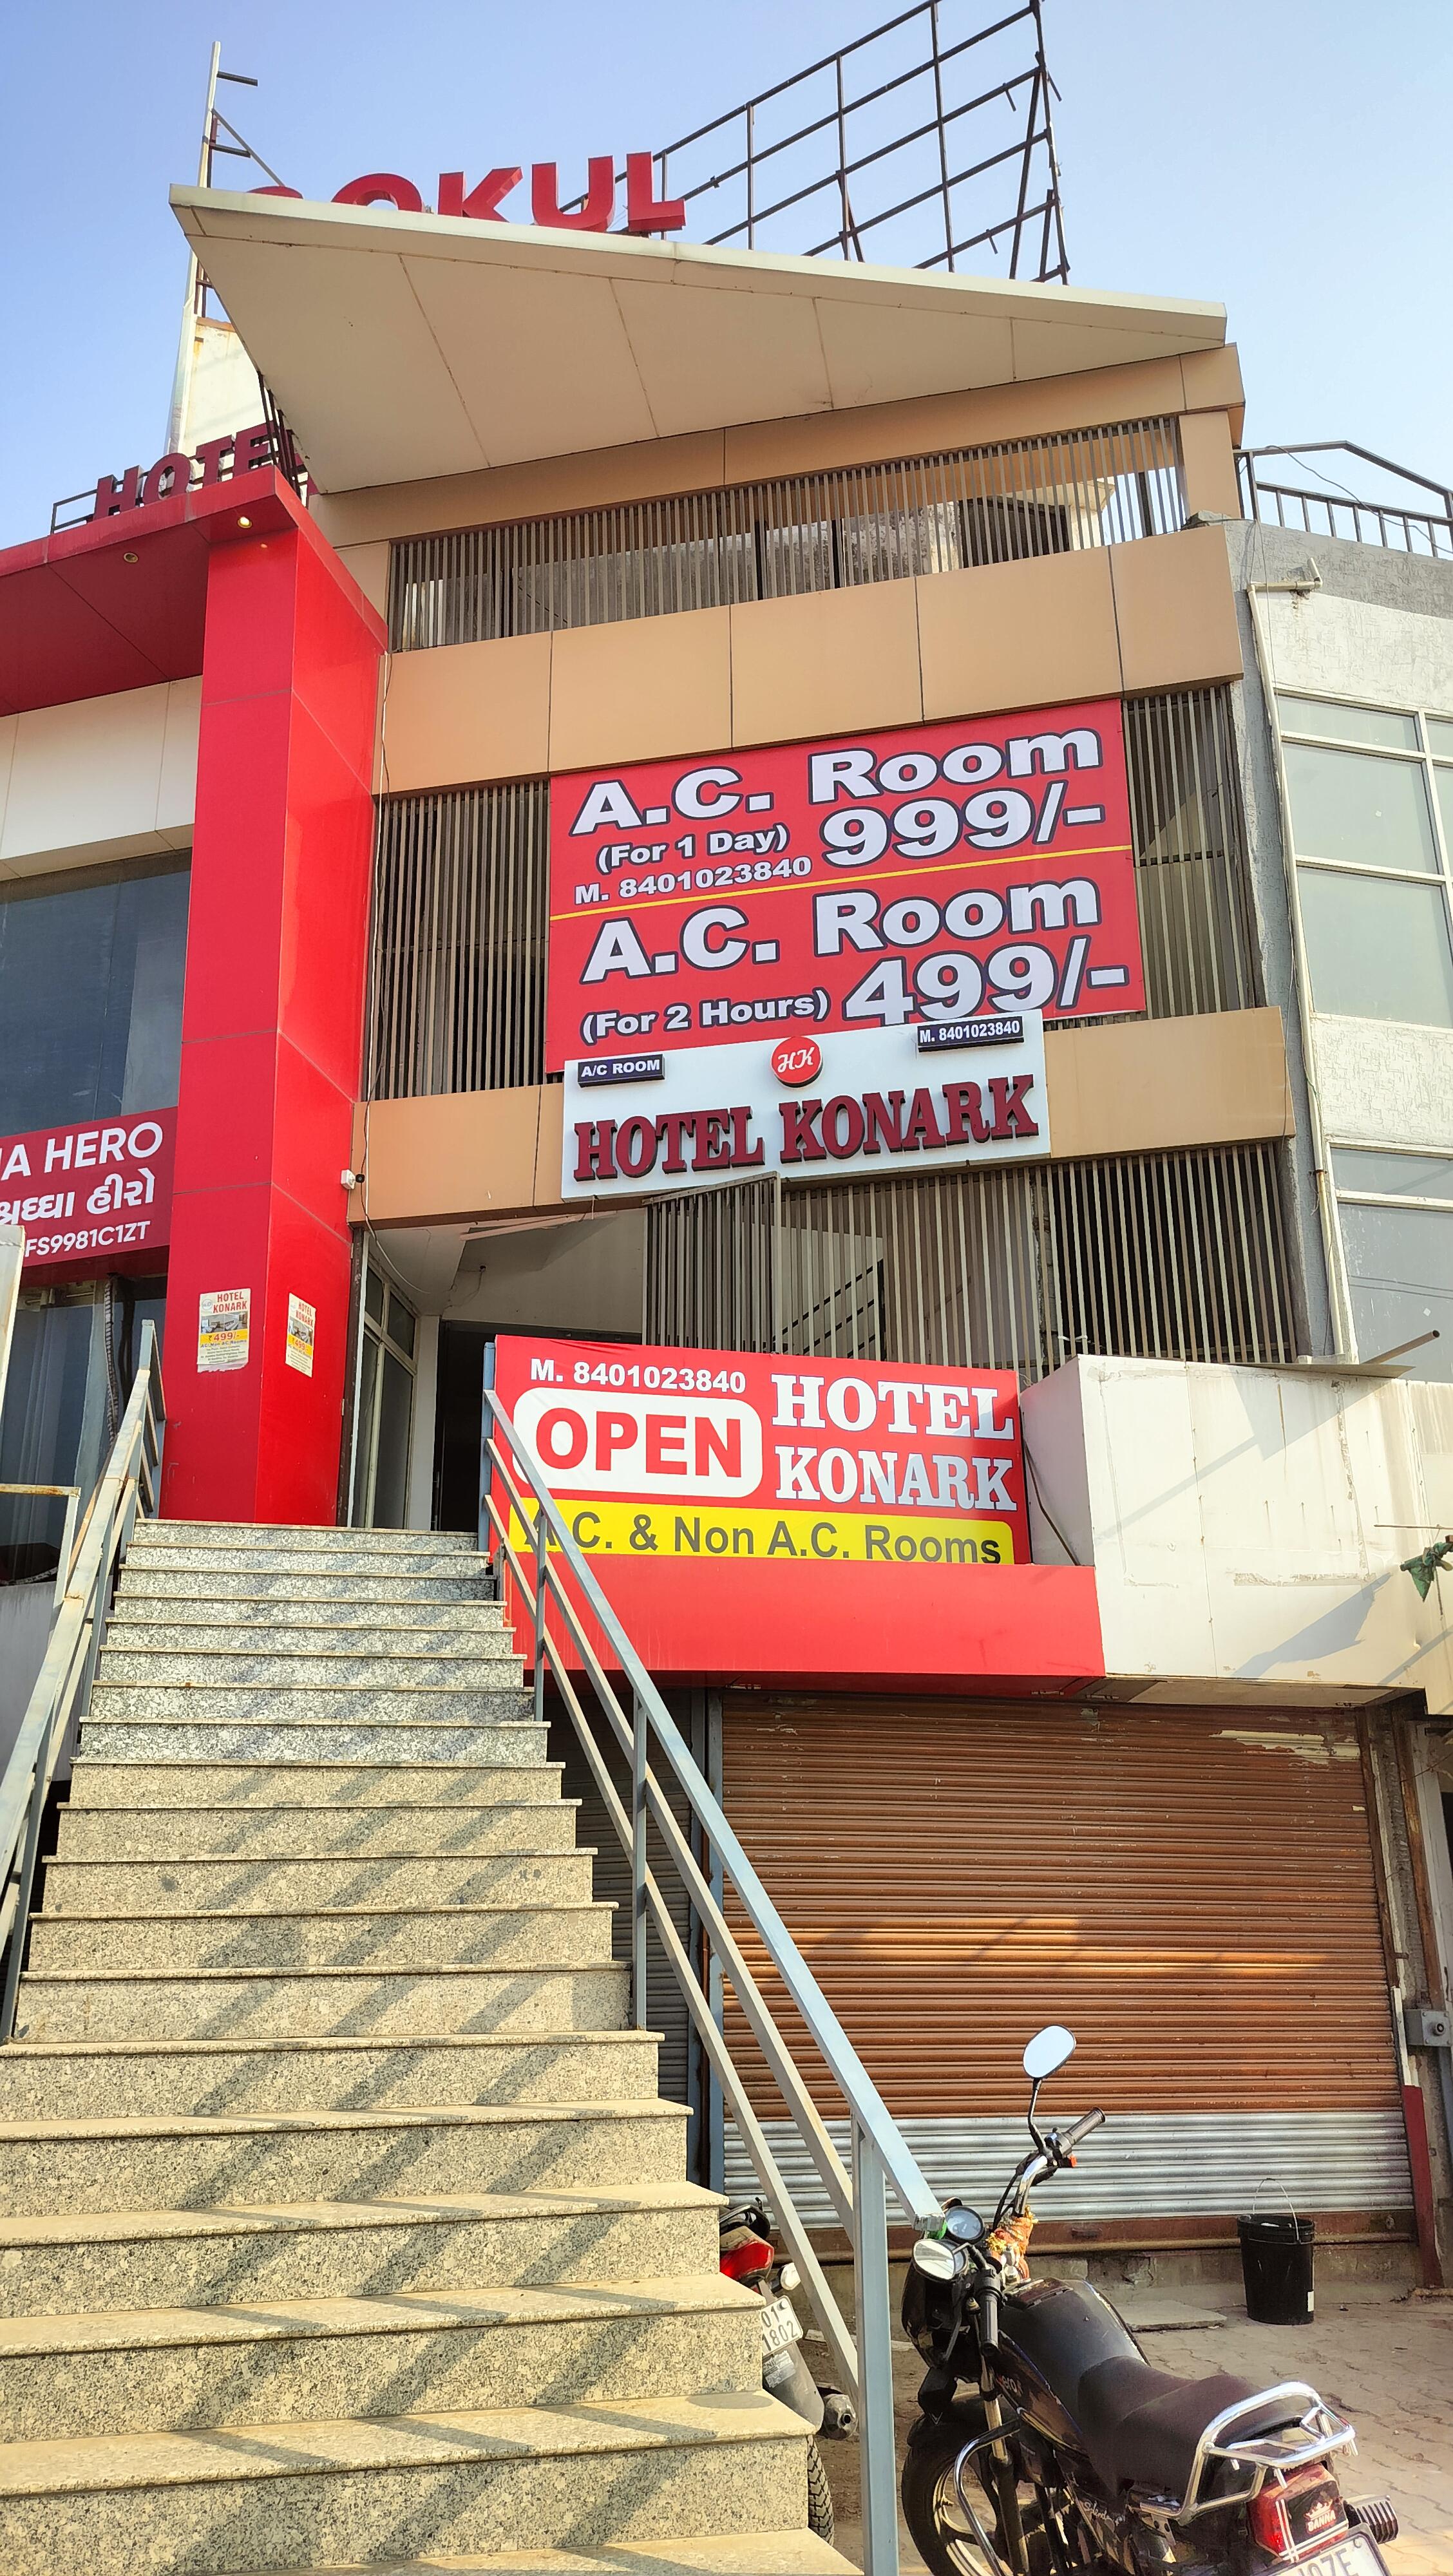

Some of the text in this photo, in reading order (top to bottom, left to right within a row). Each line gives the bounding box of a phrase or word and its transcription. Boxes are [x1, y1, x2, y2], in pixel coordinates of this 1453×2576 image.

[246, 151, 686, 232] OKUL
[570, 728, 1103, 836] A.C. Room
[596, 823, 790, 874] (For 1 Day)
[820, 779, 1105, 867] 999/-
[574, 856, 813, 905] M. 8401023840
[581, 878, 1101, 985] A.C. Room
[842, 935, 1128, 1025] 499/-
[582, 988, 830, 1045] (For 2 Hours)
[919, 1020, 1020, 1045] M. 8401023840
[580, 1058, 661, 1079] A/C ROOM
[0, 1121, 163, 1180] A HERO
[573, 1074, 1039, 1181] HOTEL KONARK
[213, 1300, 247, 1313] KONARK
[217, 1291, 243, 1302] HOTEL
[298, 1302, 312, 1317] HOTEL
[531, 1358, 746, 1394] M. 8401023840
[772, 1374, 1014, 1440] HOTEL
[536, 1407, 742, 1478] OPEN
[775, 1445, 1018, 1511] KONARK
[629, 1514, 656, 1551] &
[674, 1515, 755, 1555] Non
[767, 1520, 850, 1558] A.C.
[866, 1526, 1002, 1564] Rooms
[761, 2320, 798, 2351] 1802
